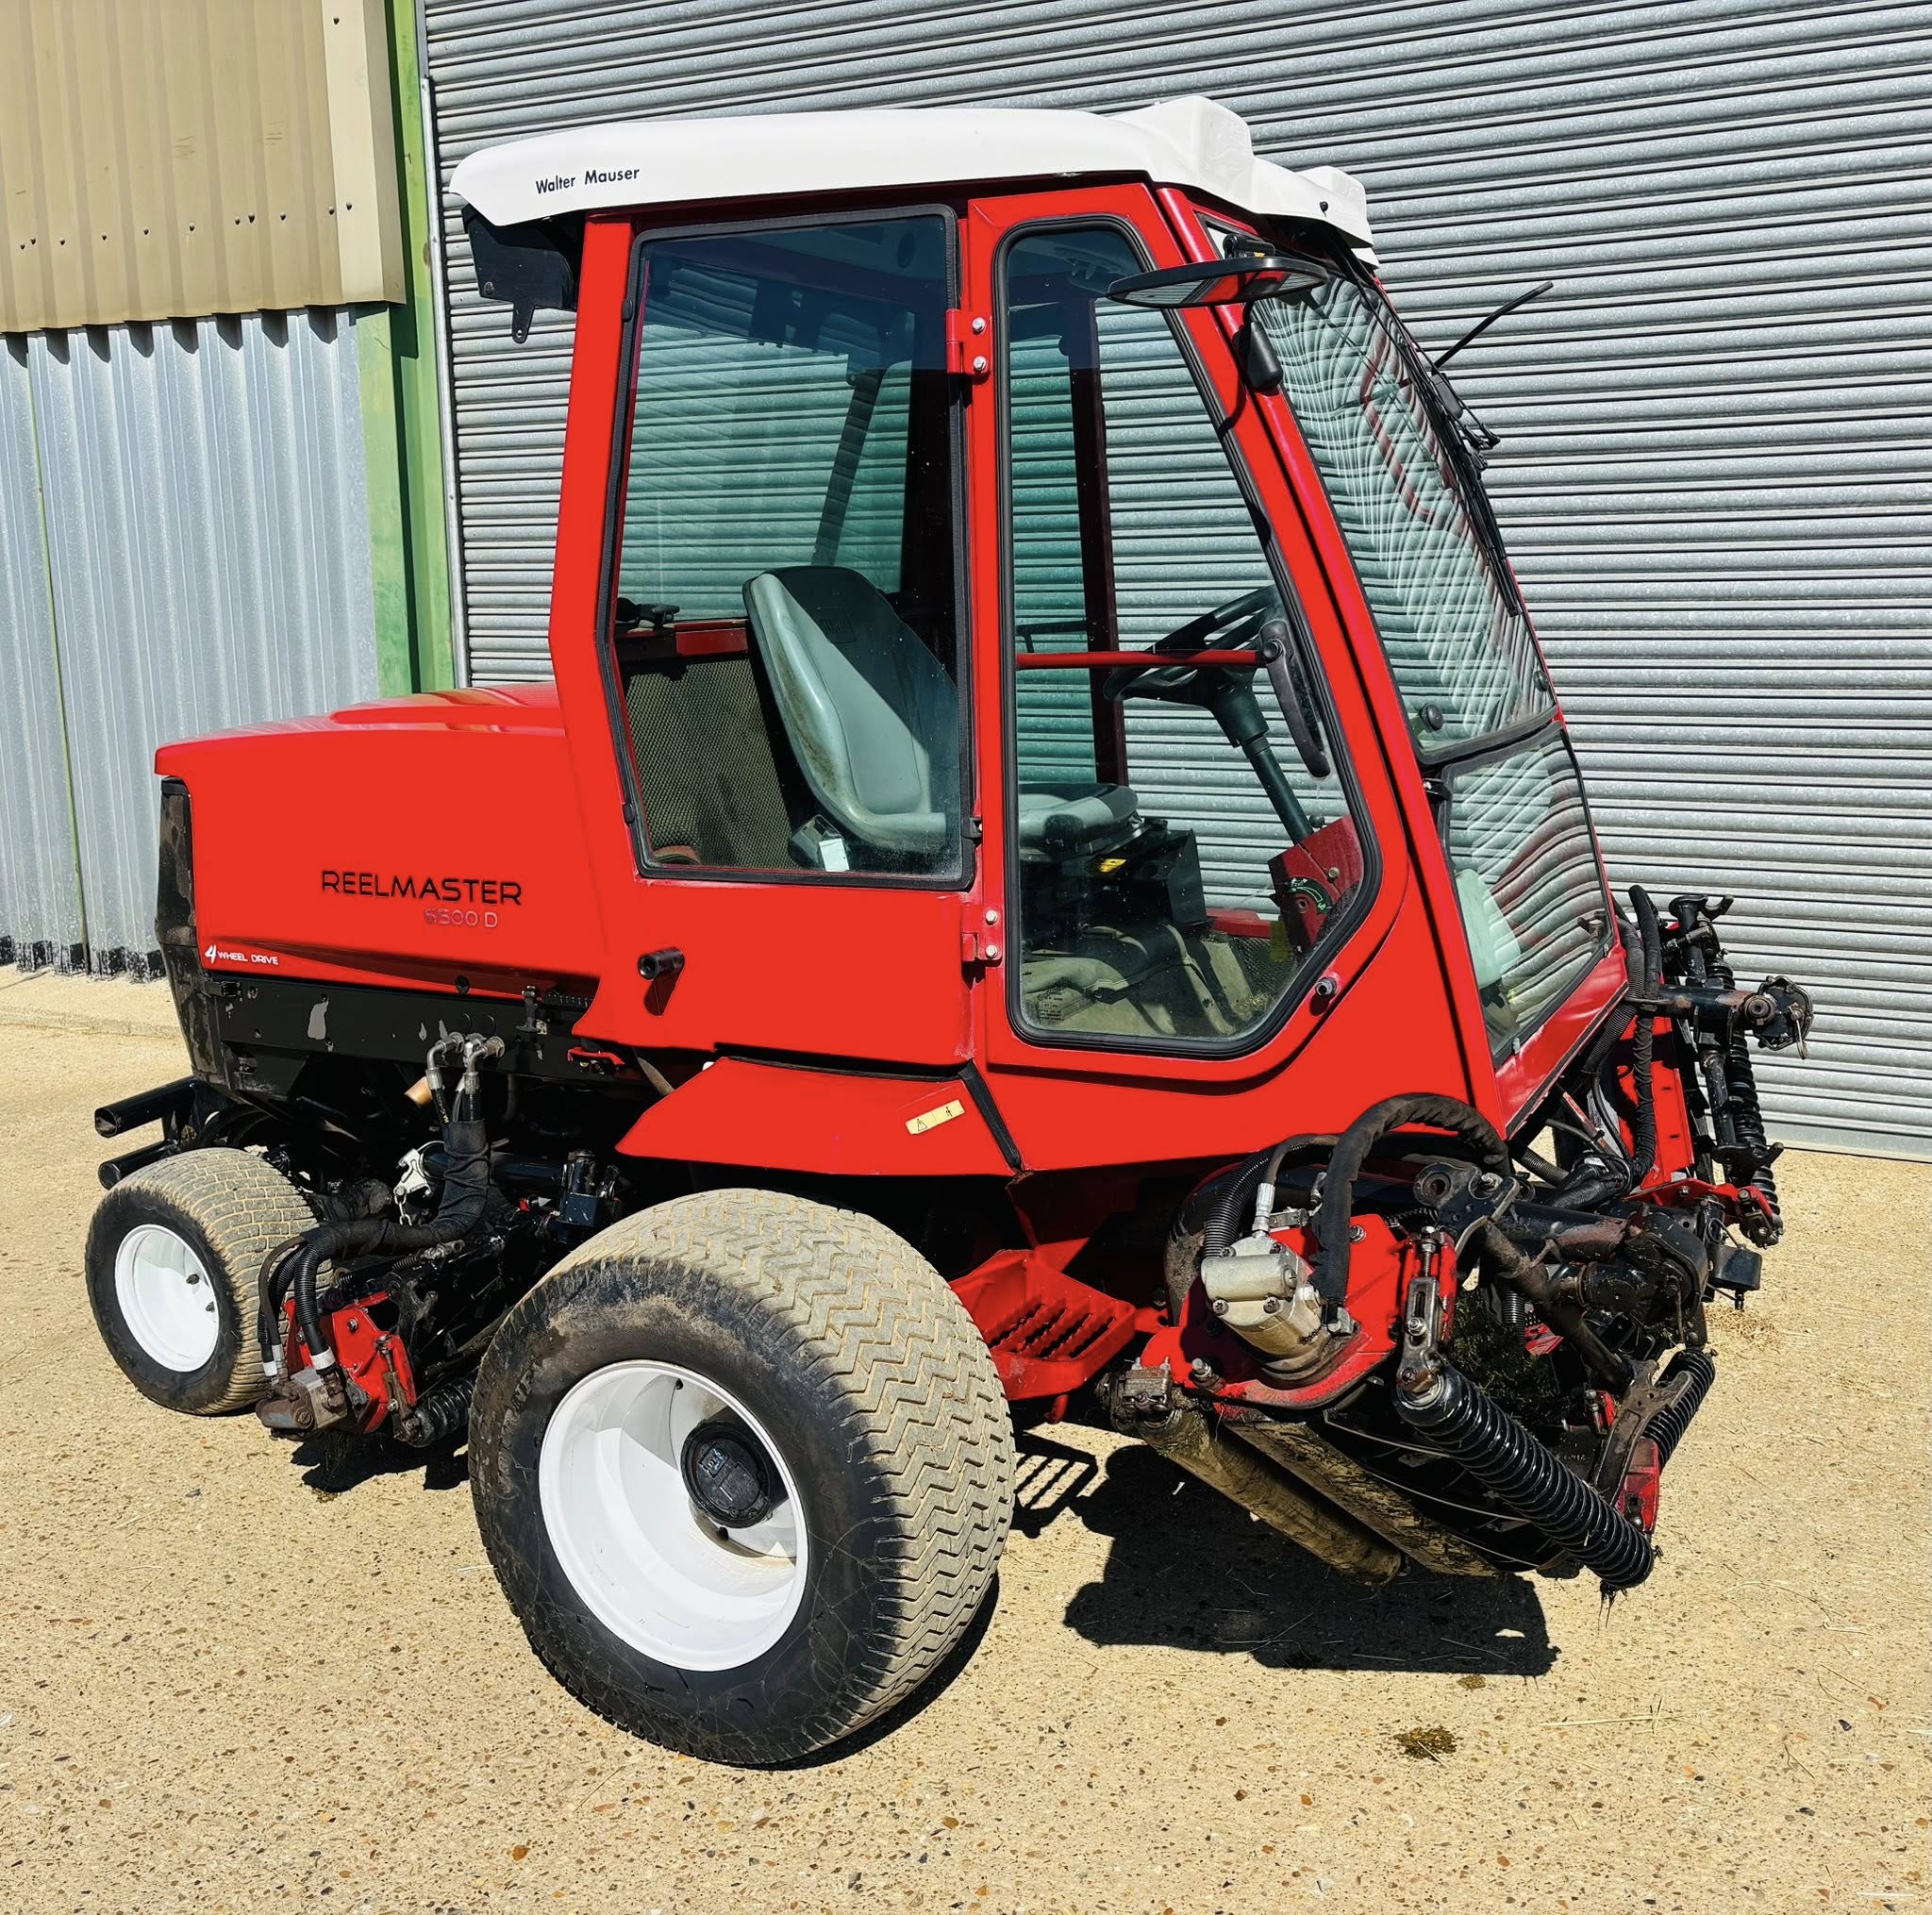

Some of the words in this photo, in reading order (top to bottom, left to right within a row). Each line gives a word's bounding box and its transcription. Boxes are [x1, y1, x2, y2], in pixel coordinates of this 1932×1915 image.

[535, 175, 575, 194] Walter
[584, 169, 641, 185] Mauser
[322, 870, 522, 906] REELMASTER
[484, 911, 499, 928] D
[205, 944, 217, 964] 4
[217, 951, 248, 962] WHEEL
[250, 954, 279, 966] DRIVE
